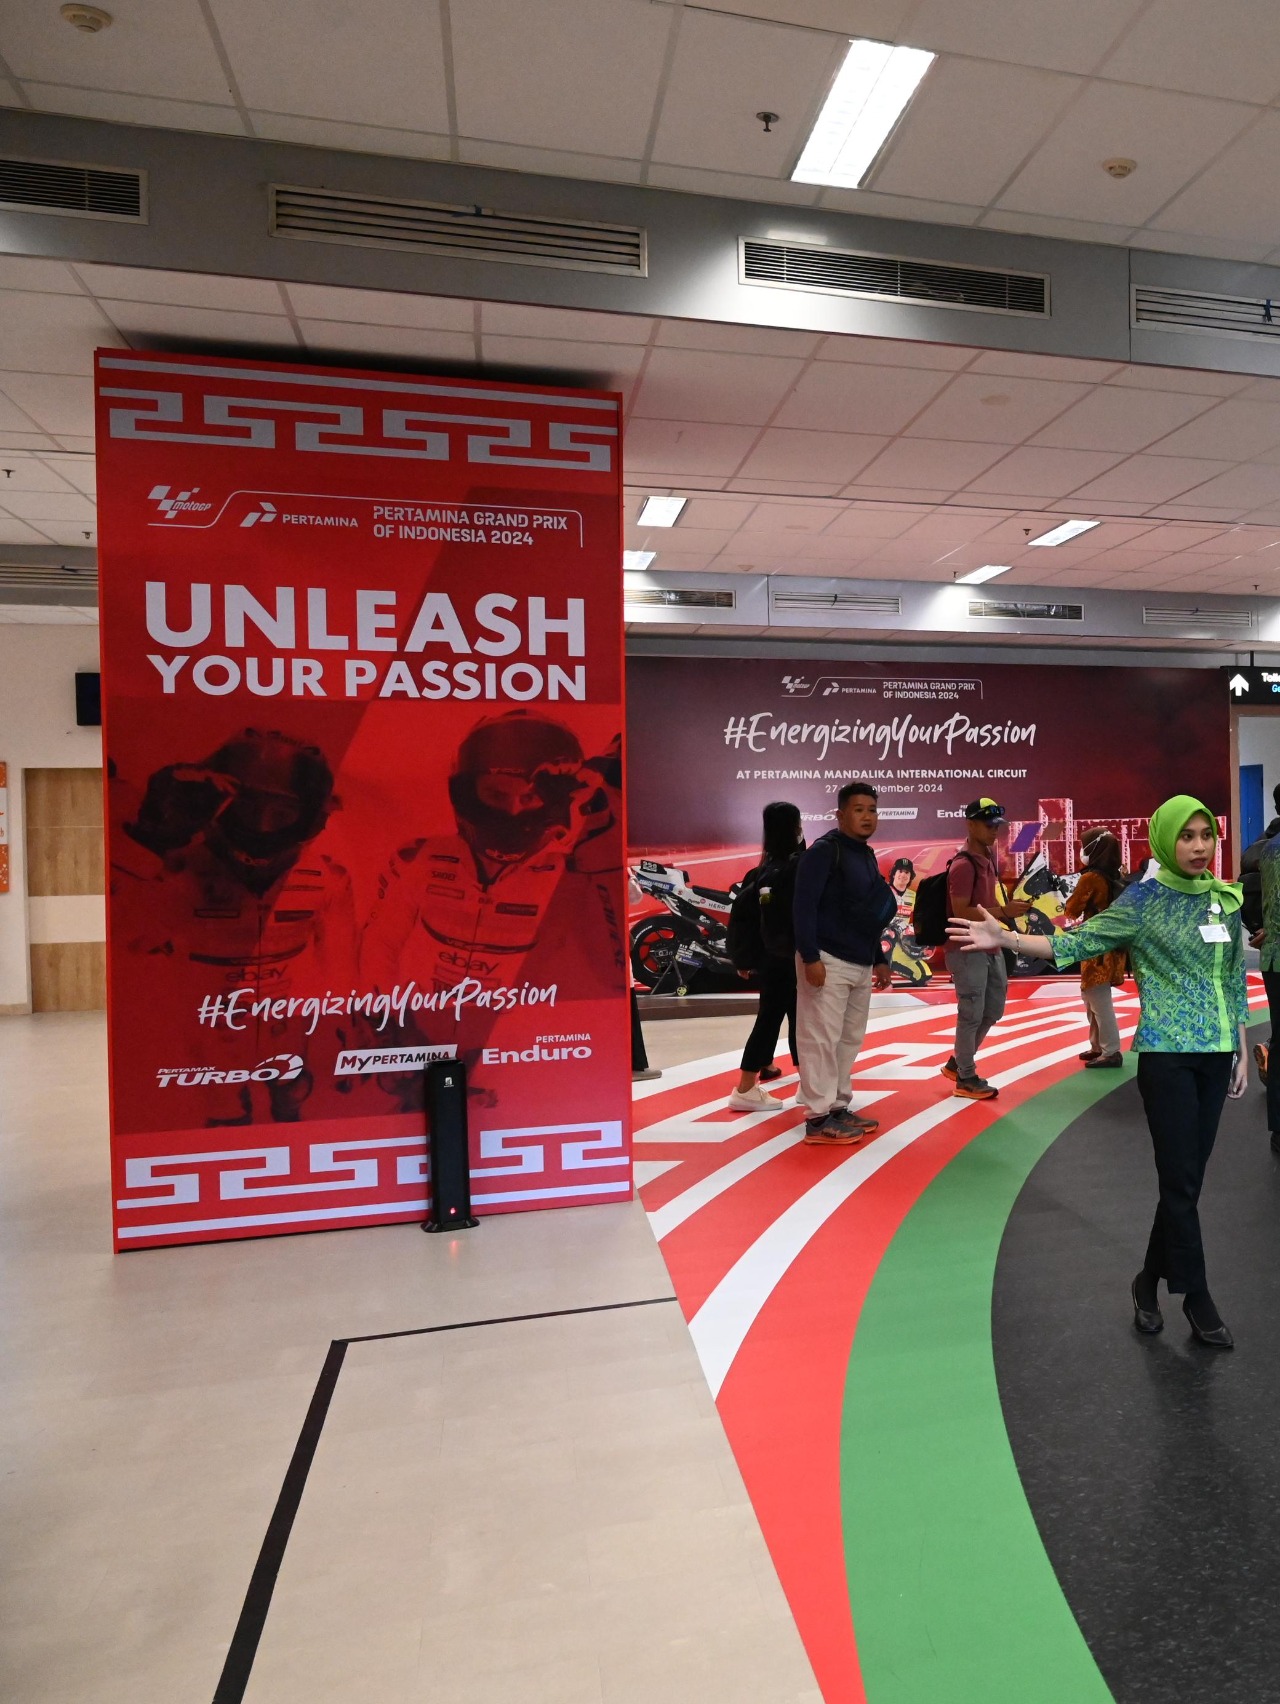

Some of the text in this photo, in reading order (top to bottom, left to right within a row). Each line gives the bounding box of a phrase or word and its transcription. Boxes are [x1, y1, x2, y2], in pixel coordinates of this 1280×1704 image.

[283, 514, 358, 527] PERTAMINA
[373, 506, 568, 530] PERTAMINA GRAND PRIX
[373, 524, 534, 545] OF INDONESIA 2024
[145, 581, 585, 656] UNLEASH
[146, 655, 586, 701] YOUR PASSION
[883, 681, 976, 691] PERTAMINA GRAND PRIX
[883, 691, 959, 700] OF INDONESIA 2024
[724, 712, 1036, 761] #EnergizingYourPassion
[736, 768, 1027, 779] AT PERTAMINA MANDALIKA INTERNATIONAL CIRCUIT
[918, 784, 943, 793] 2024
[197, 976, 558, 1036] #EnergizingYourPassion
[536, 1033, 592, 1044] PERTAMINA
[482, 1044, 593, 1065] Enduro
[156, 1068, 281, 1088] TURBO
[157, 1066, 216, 1075] PERTAMAX
